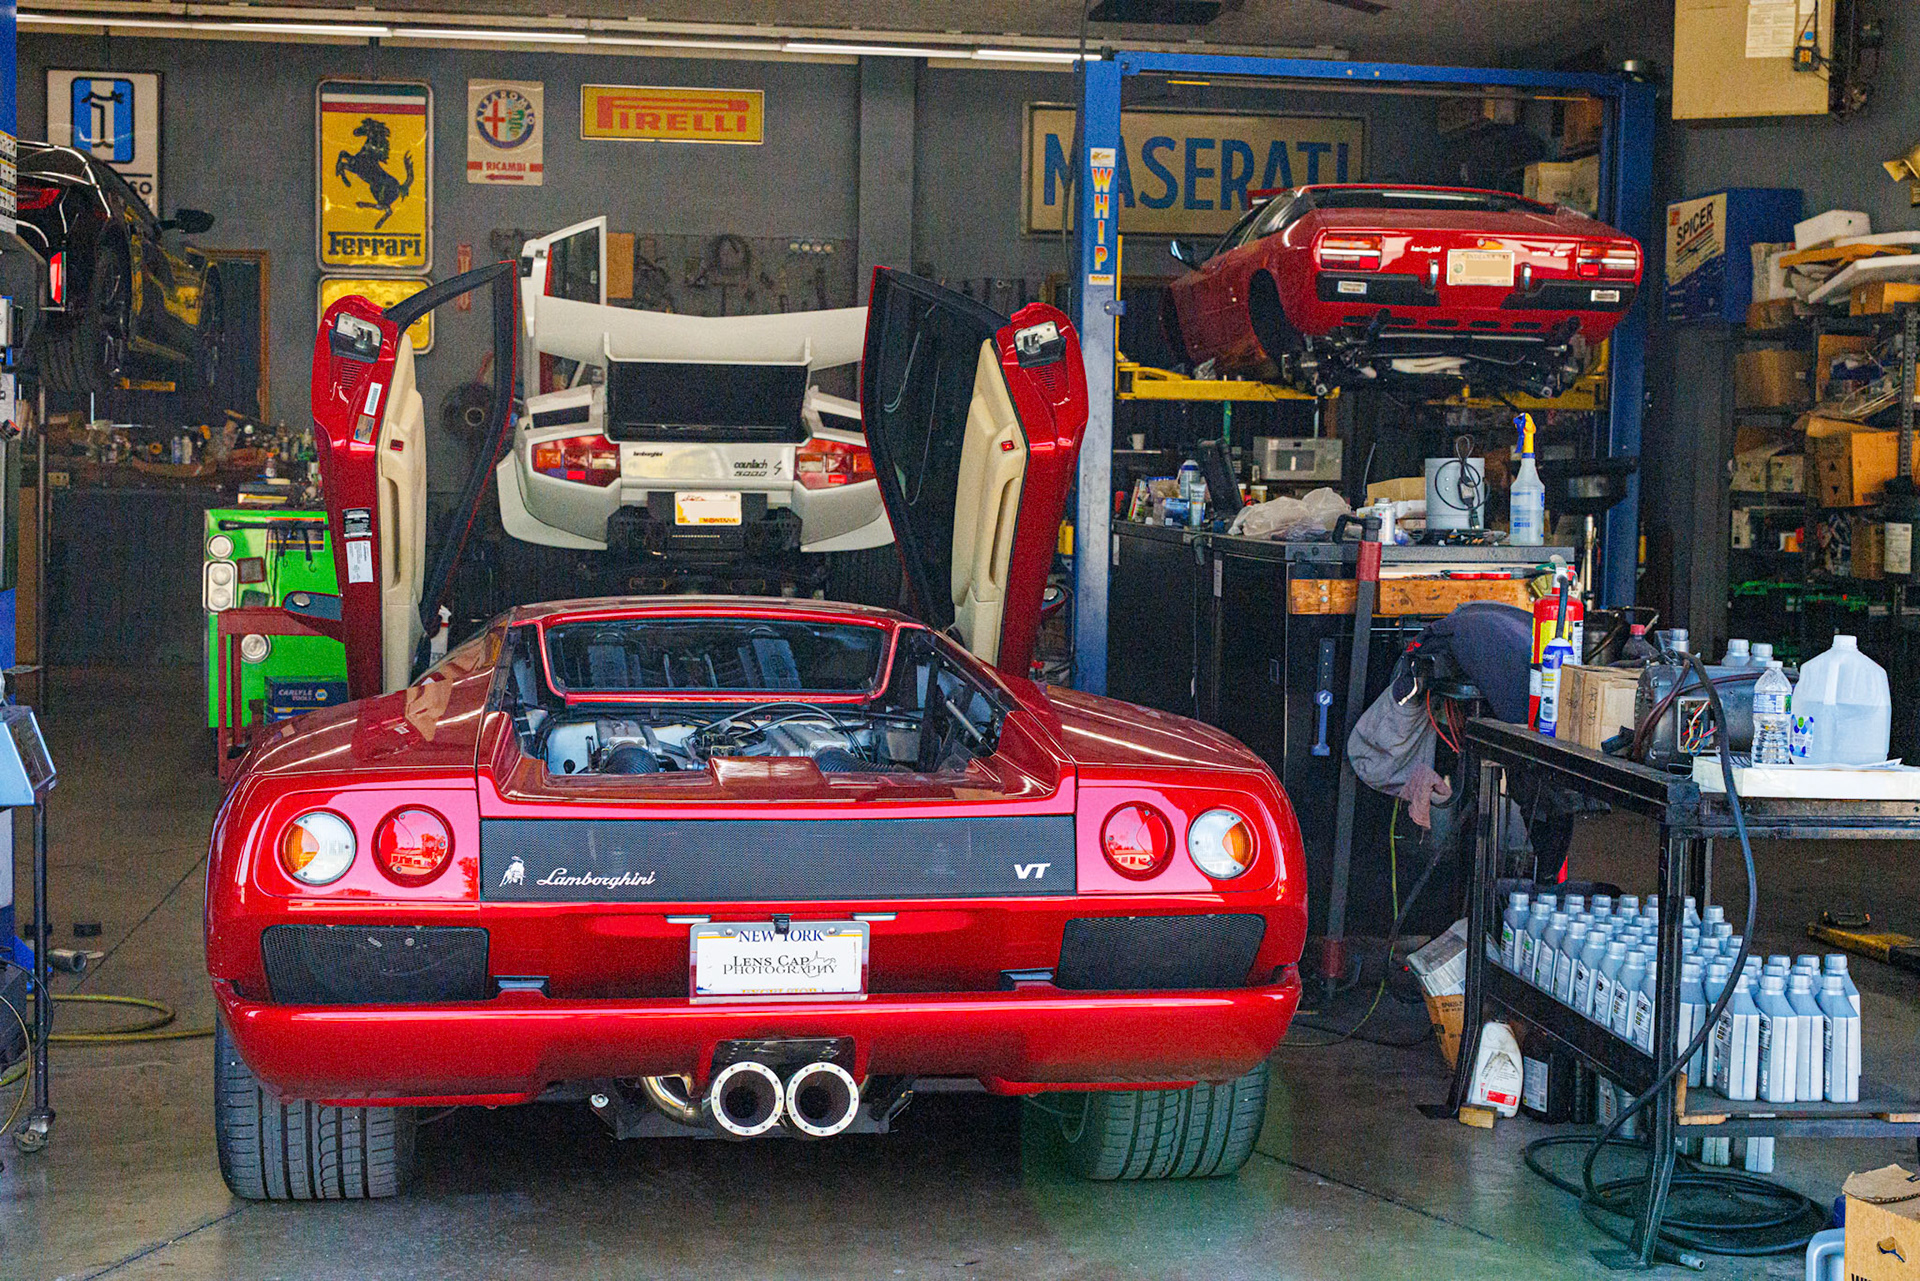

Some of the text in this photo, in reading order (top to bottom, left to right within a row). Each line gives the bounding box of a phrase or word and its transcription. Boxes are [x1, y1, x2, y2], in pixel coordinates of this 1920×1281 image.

[597, 95, 749, 132] PIRELLI
[486, 161, 526, 172] RICAMBI
[1091, 167, 1114, 270] WHIP
[1676, 201, 1714, 246] SPICER
[328, 231, 421, 256] Ferrari
[537, 868, 656, 889] Lamborghini
[1014, 863, 1051, 879] VT
[739, 930, 776, 942] NEW
